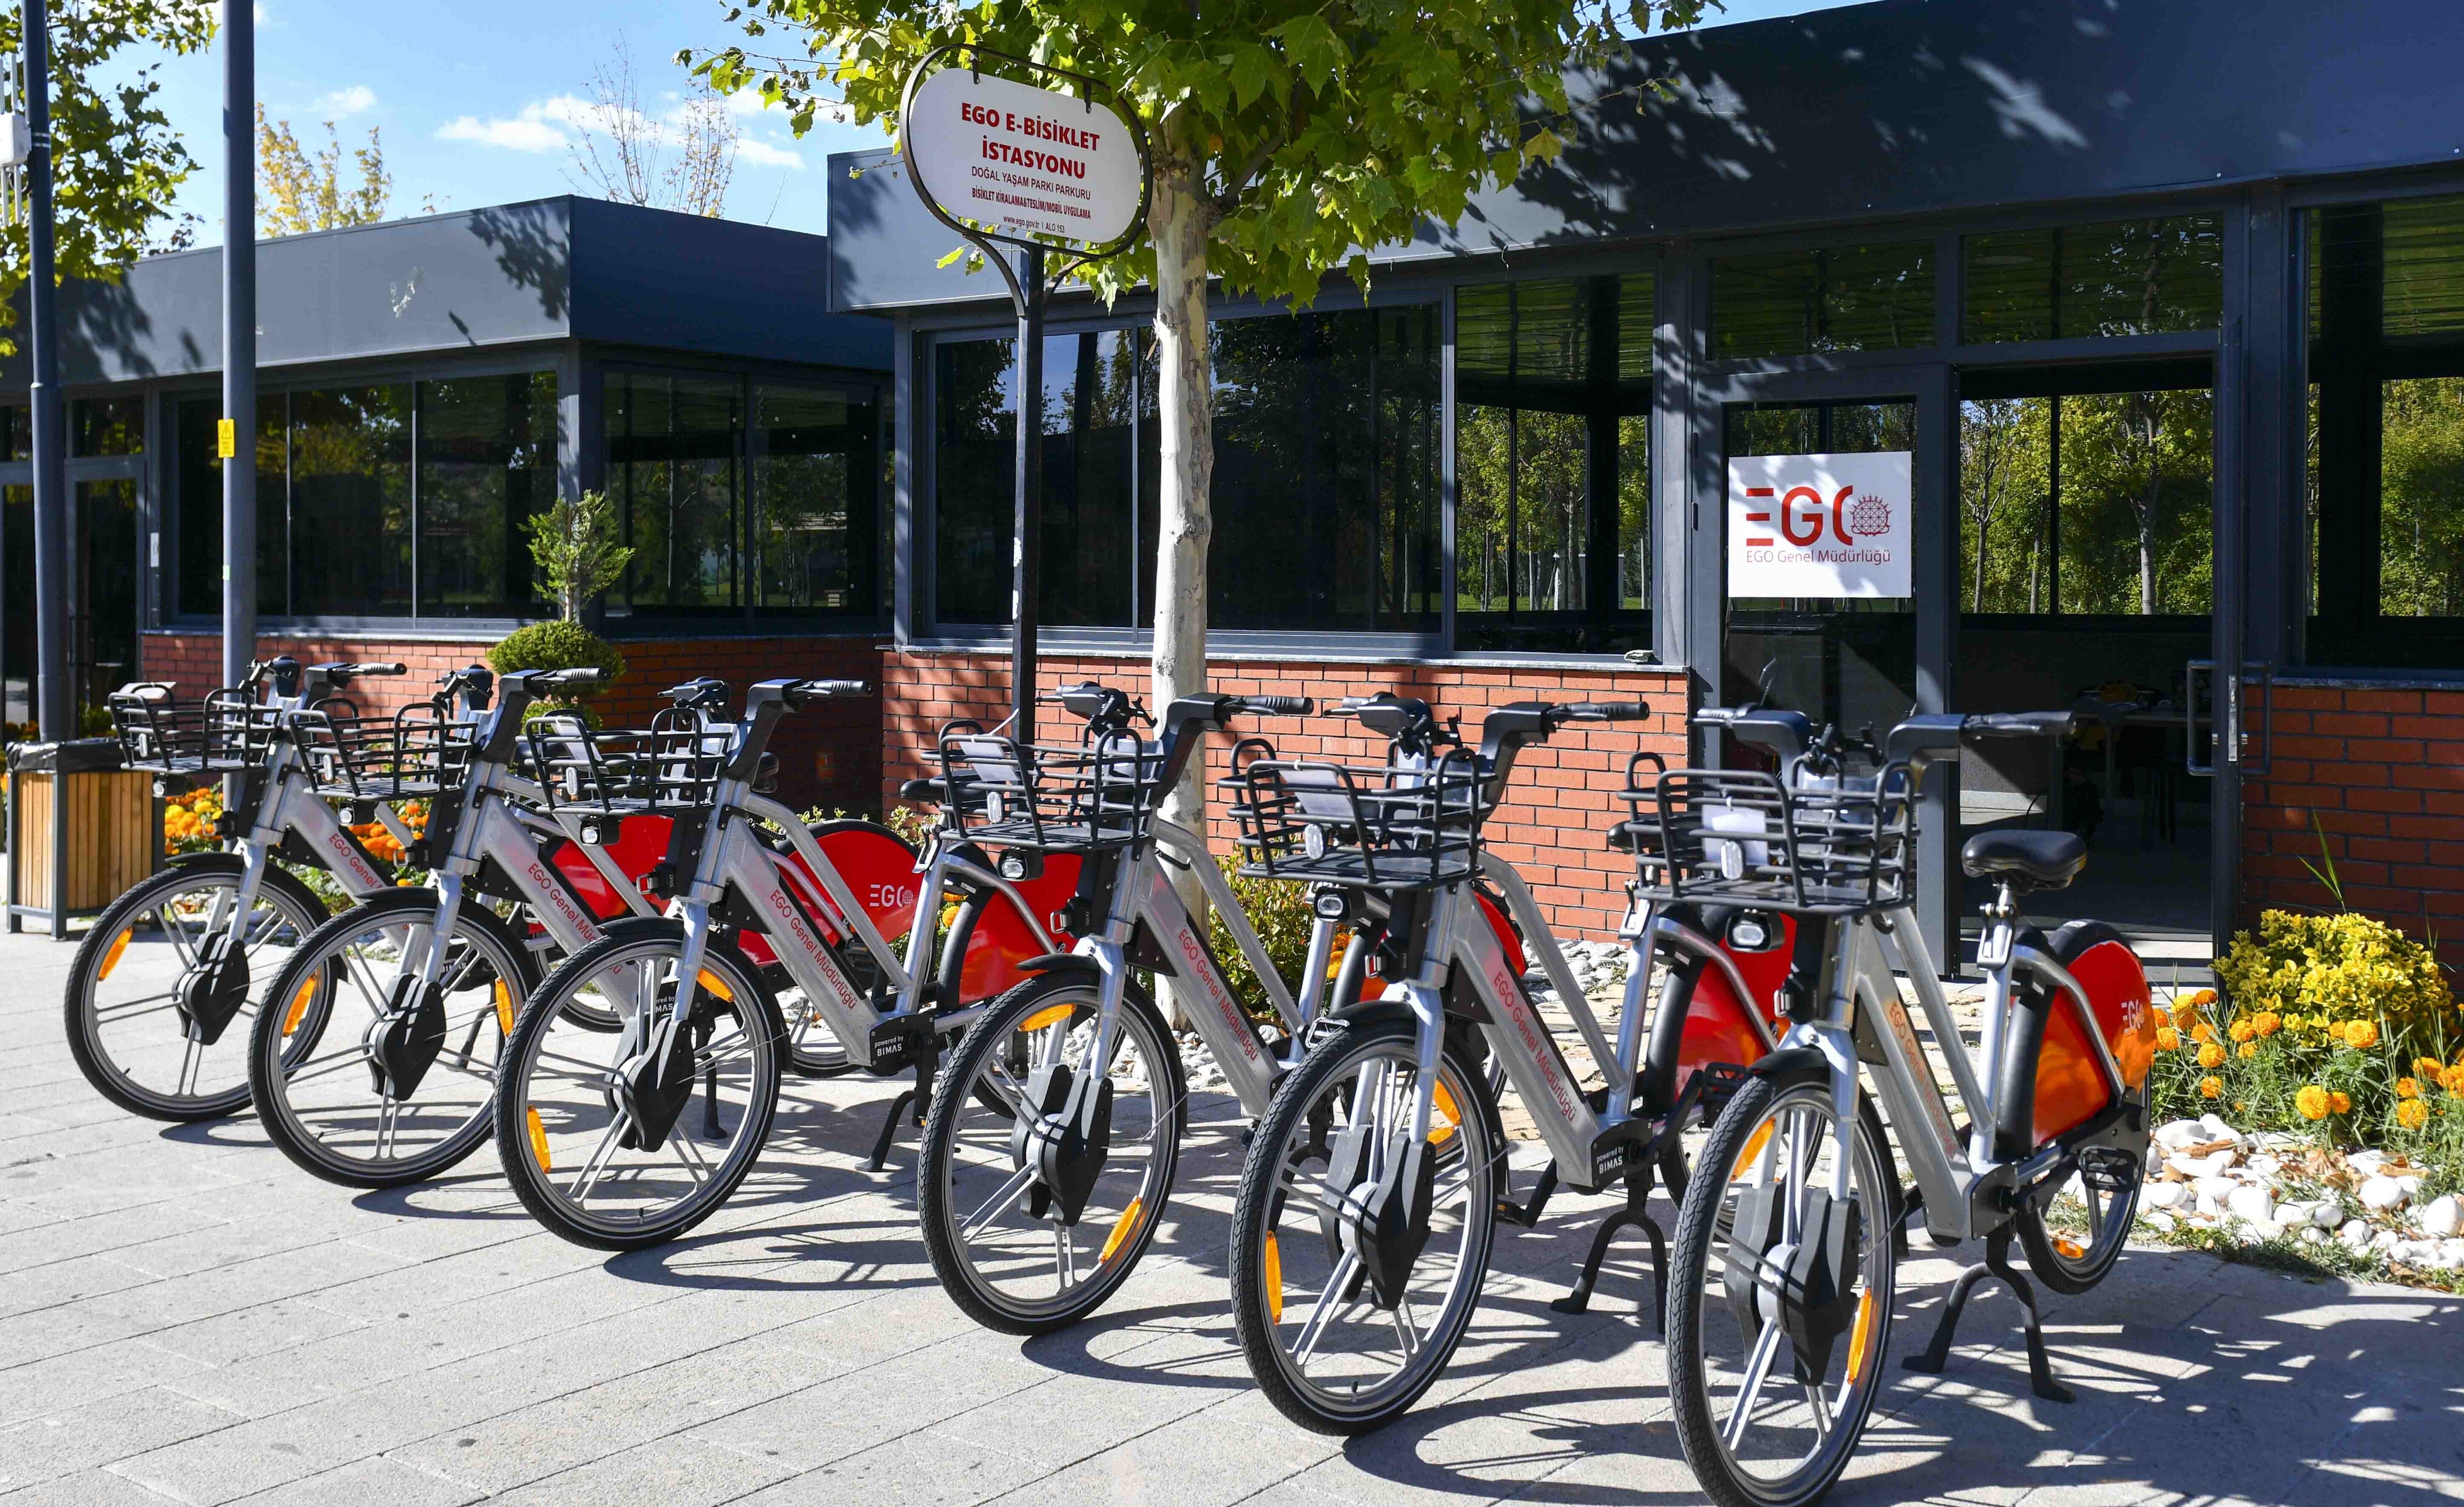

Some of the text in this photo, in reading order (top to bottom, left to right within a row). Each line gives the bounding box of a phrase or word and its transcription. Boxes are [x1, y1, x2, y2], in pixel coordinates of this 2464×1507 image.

[962, 102, 1100, 151] EGO E-BİSİKLET
[982, 135, 1085, 179] İSTASYONU
[972, 166, 1091, 200] DOĞAL YAŞAM PARKI PARKURU
[972, 185, 995, 201] BİSİKLET
[1064, 205, 1091, 220] UYGULAMA
[1003, 215, 1040, 229] www.ego.gov.tr
[1045, 222, 1056, 232] ALO
[1056, 224, 1065, 233] 153
[1746, 485, 1853, 547] EGO
[1746, 549, 1891, 566] EGO Genel Müdürlüğü
[329, 832, 378, 887] EGO Genel
[528, 862, 579, 923] EGO Genel
[770, 889, 857, 1010] EGO Genel Müdürlüğü
[1179, 928, 1259, 1061] EGO Genel Müdürlüğü
[1890, 1002, 1906, 1039] EGO
[875, 1036, 897, 1049] powered
[877, 1043, 902, 1057] BIMAS
[1494, 971, 1576, 1122] EGO Genel Müdürlüğü
[1599, 1155, 1623, 1175] BIMAS
